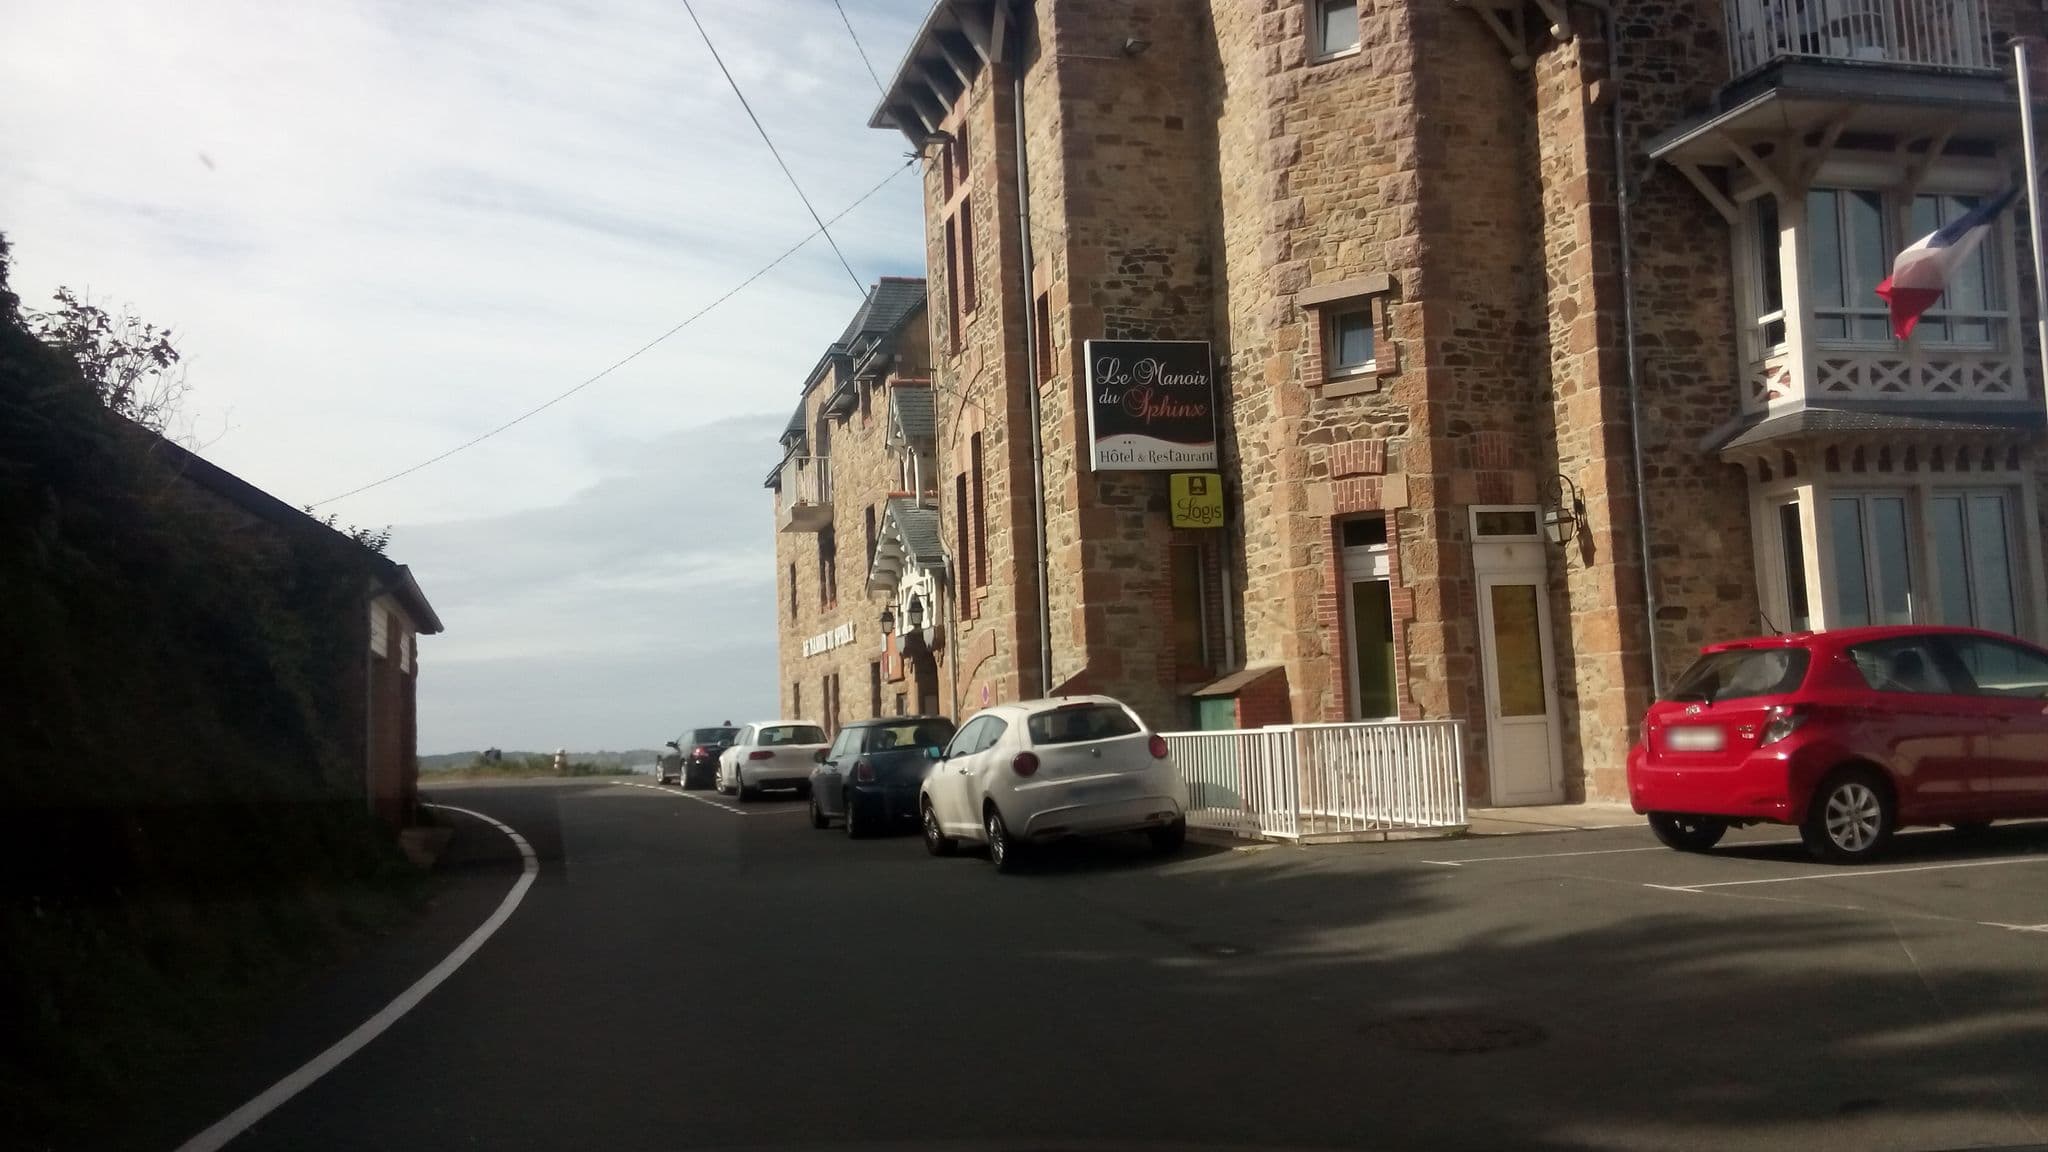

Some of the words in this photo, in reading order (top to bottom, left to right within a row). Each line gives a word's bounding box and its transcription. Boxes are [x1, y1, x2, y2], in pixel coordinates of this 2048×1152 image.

[1096, 357, 1131, 385] Le
[1133, 357, 1208, 386] Manoir
[1099, 388, 1120, 404] du
[1123, 385, 1208, 424] Sphinx
[1100, 449, 1134, 463] Hôtel
[1138, 455, 1145, 463] &
[1149, 449, 1215, 463] Restaurant
[1176, 497, 1222, 524] Logis
